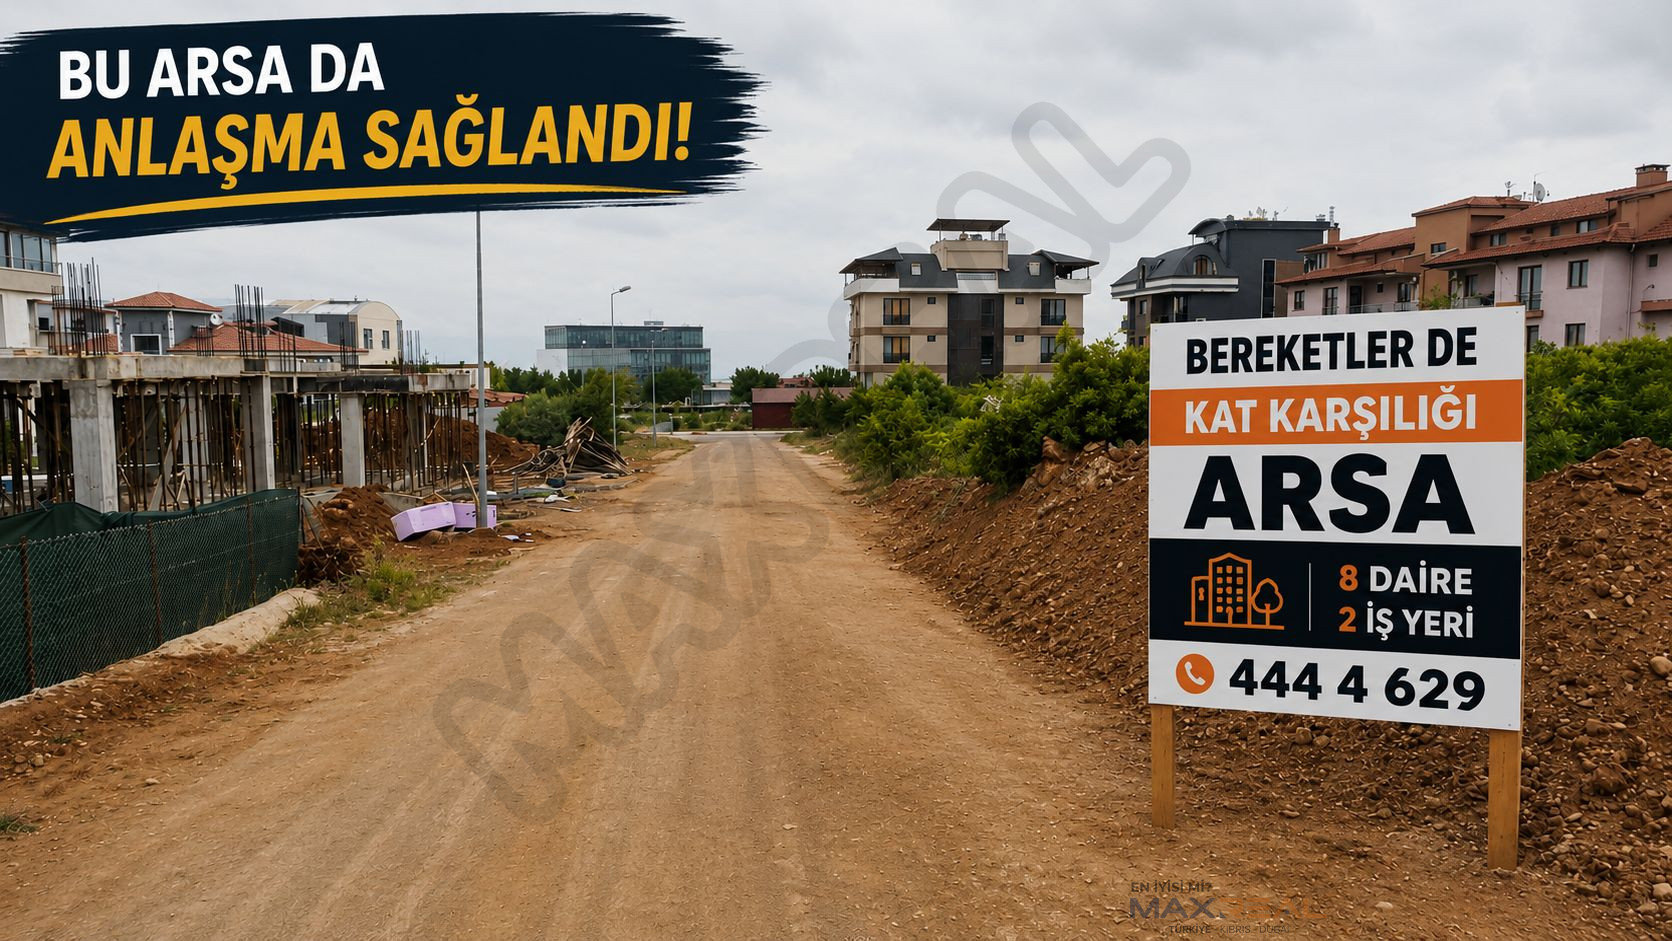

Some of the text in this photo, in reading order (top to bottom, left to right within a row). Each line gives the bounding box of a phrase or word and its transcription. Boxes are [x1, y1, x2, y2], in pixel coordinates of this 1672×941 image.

[1187, 327, 1476, 374] BEREKETLER DE
[1186, 385, 1476, 440] KAT KARŞILIĞI
[1184, 453, 1475, 534] ARSA
[1340, 560, 1472, 595] 8 DAİRE
[1340, 601, 1473, 640] 2 İŞ YERİ
[1230, 659, 1485, 711] 444 4 629
